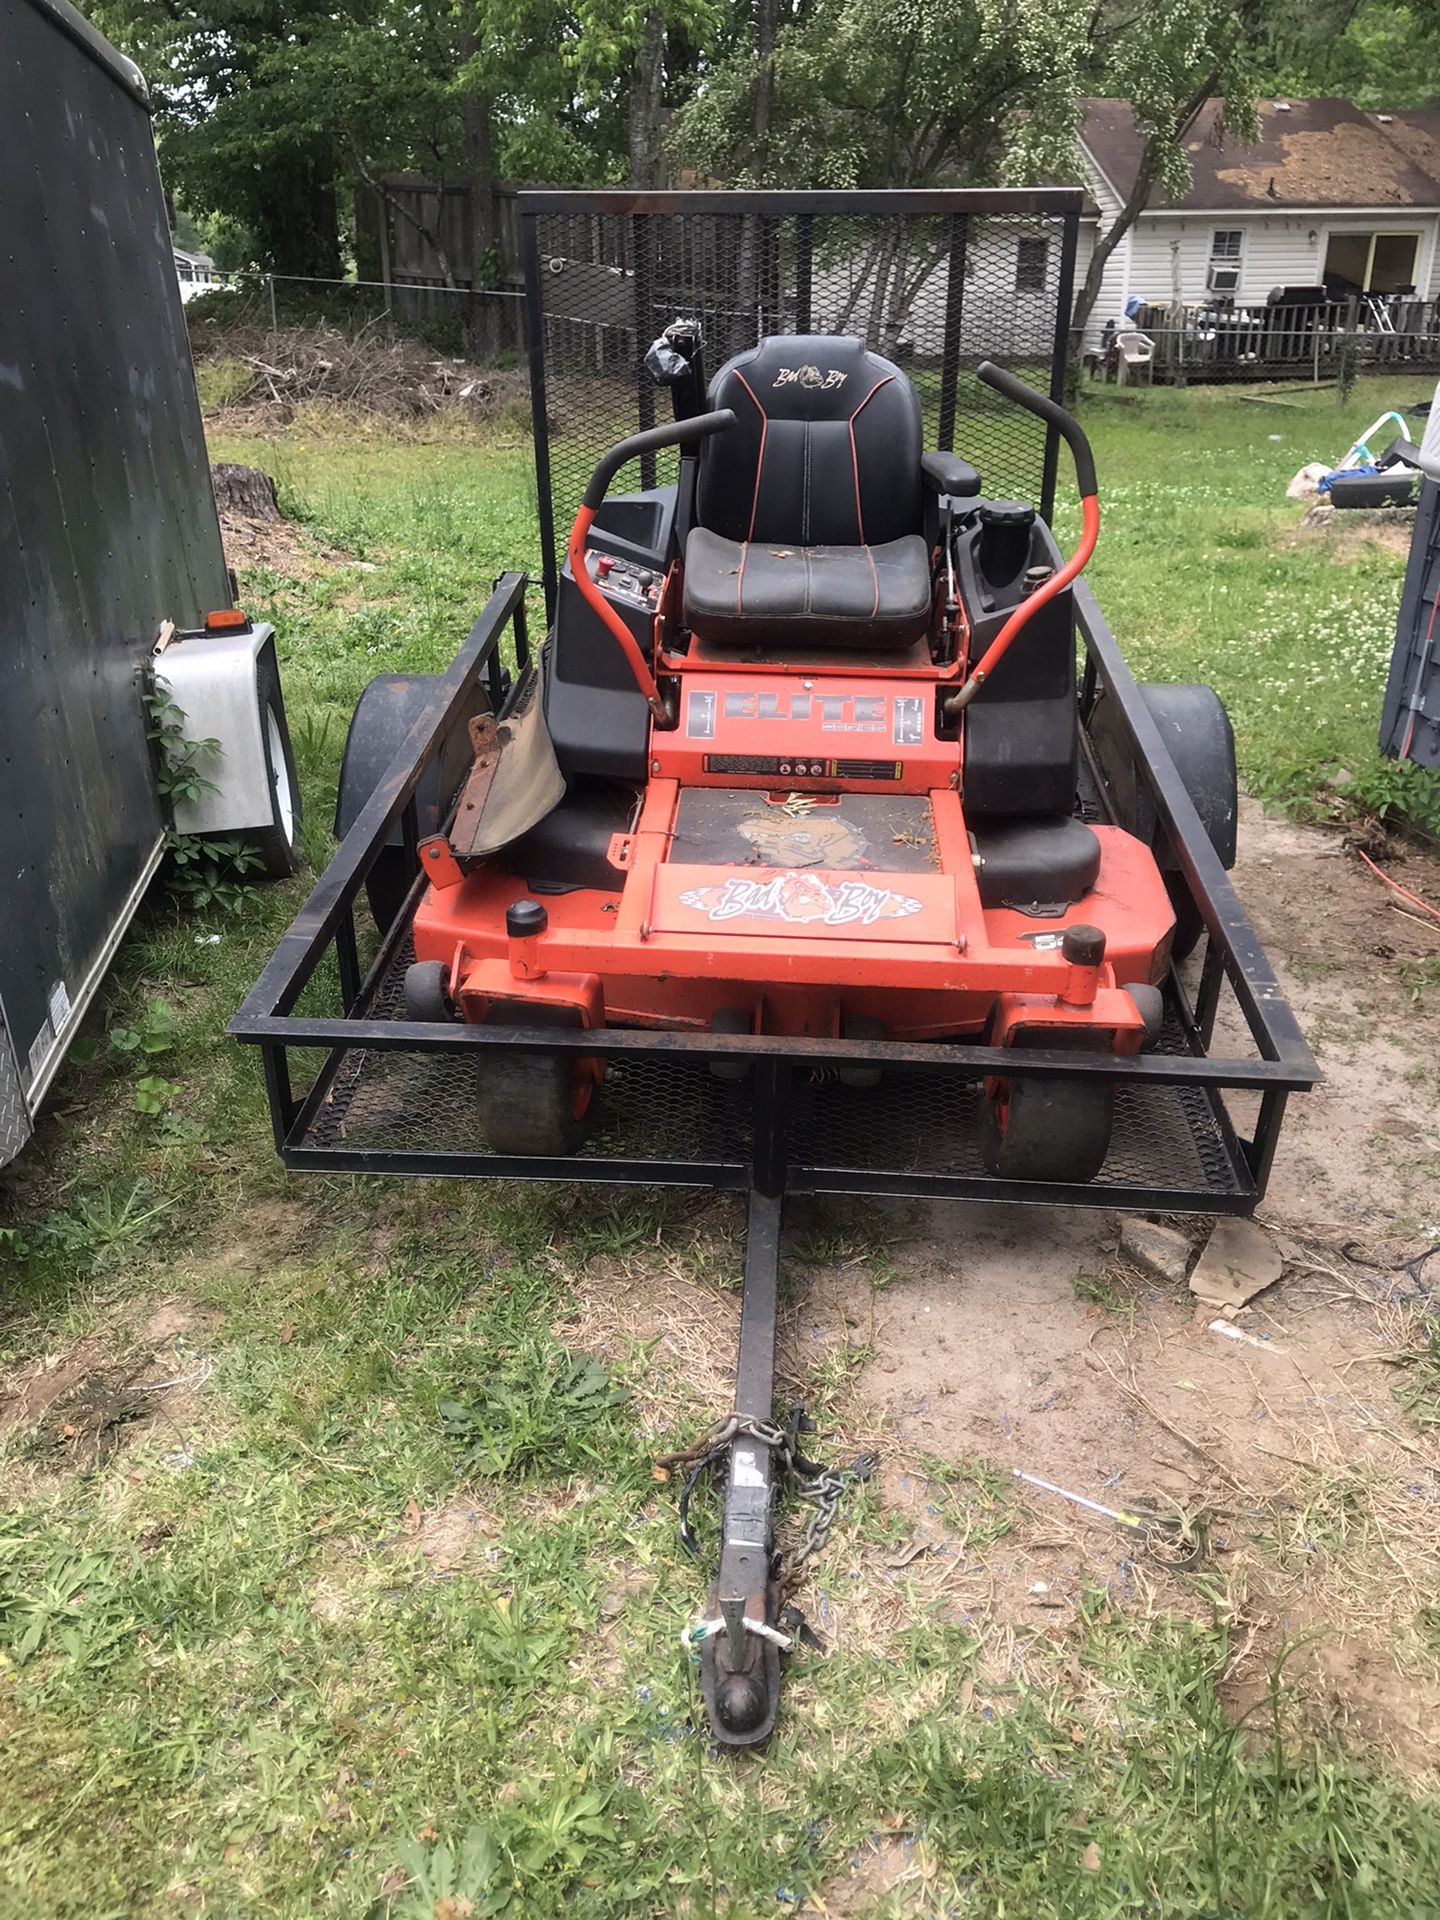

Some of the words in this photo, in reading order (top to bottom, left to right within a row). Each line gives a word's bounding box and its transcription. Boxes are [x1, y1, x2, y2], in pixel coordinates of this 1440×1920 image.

[723, 691, 887, 722] ELITE
[710, 879, 778, 920] Bad
[825, 881, 891, 924] Boy
